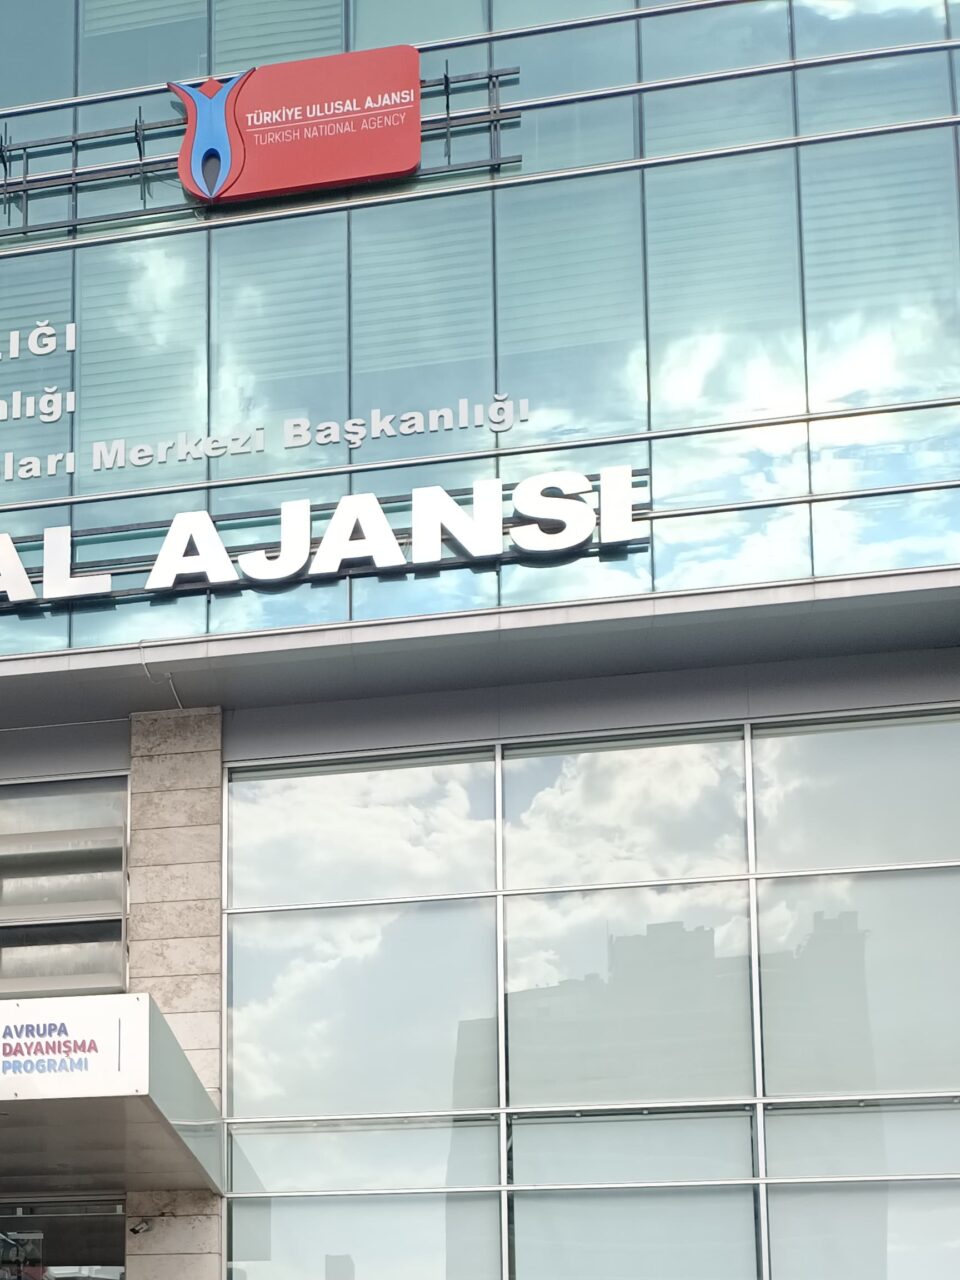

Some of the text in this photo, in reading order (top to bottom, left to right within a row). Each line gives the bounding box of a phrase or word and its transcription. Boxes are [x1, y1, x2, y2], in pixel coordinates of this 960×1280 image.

[246, 89, 415, 127] TÜRKİYE ULUSAL AJANSI
[254, 112, 407, 146] TURKISH NATIONAL AGENCY
[92, 426, 266, 472] Merkezi
[283, 392, 530, 449] Başkanlığı
[144, 465, 633, 590] AJANSI
[2, 1022, 69, 1039] AVRUPA
[2, 1039, 99, 1058] DAYANIŞMA
[1, 1057, 89, 1075] PROGRAMI
